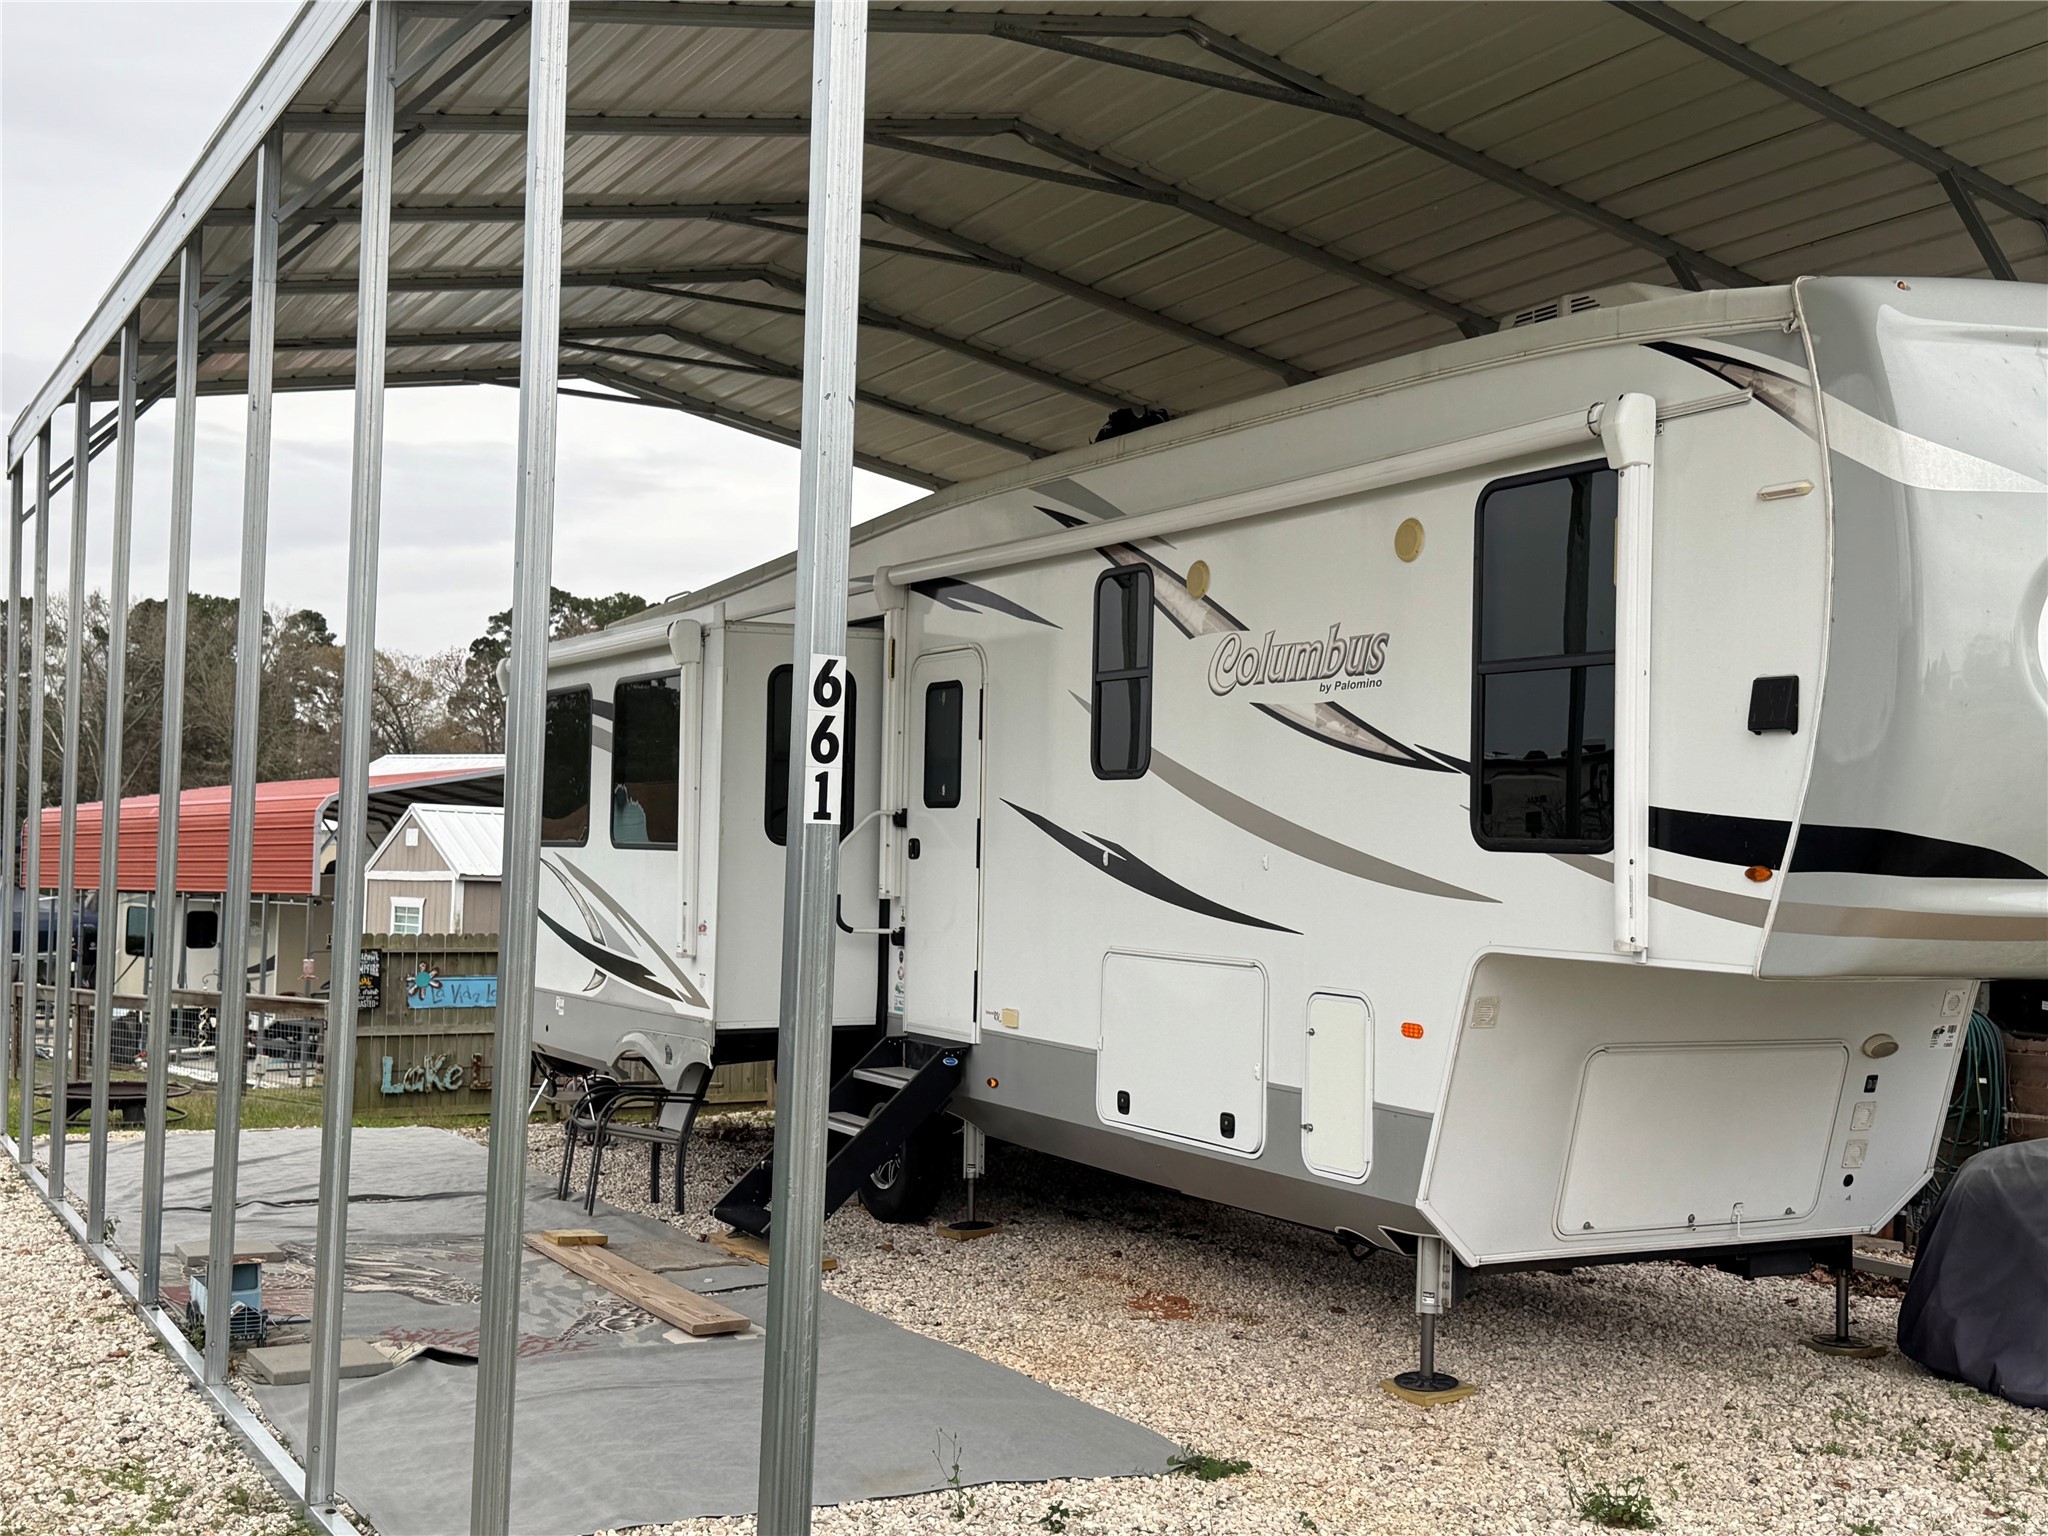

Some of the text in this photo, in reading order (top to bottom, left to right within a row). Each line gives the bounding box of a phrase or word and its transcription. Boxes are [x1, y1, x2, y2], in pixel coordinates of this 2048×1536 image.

[1208, 622, 1390, 696] Columbus
[1319, 678, 1383, 693] by Palomino
[811, 659, 842, 821] 661
[431, 986, 445, 1004] La
